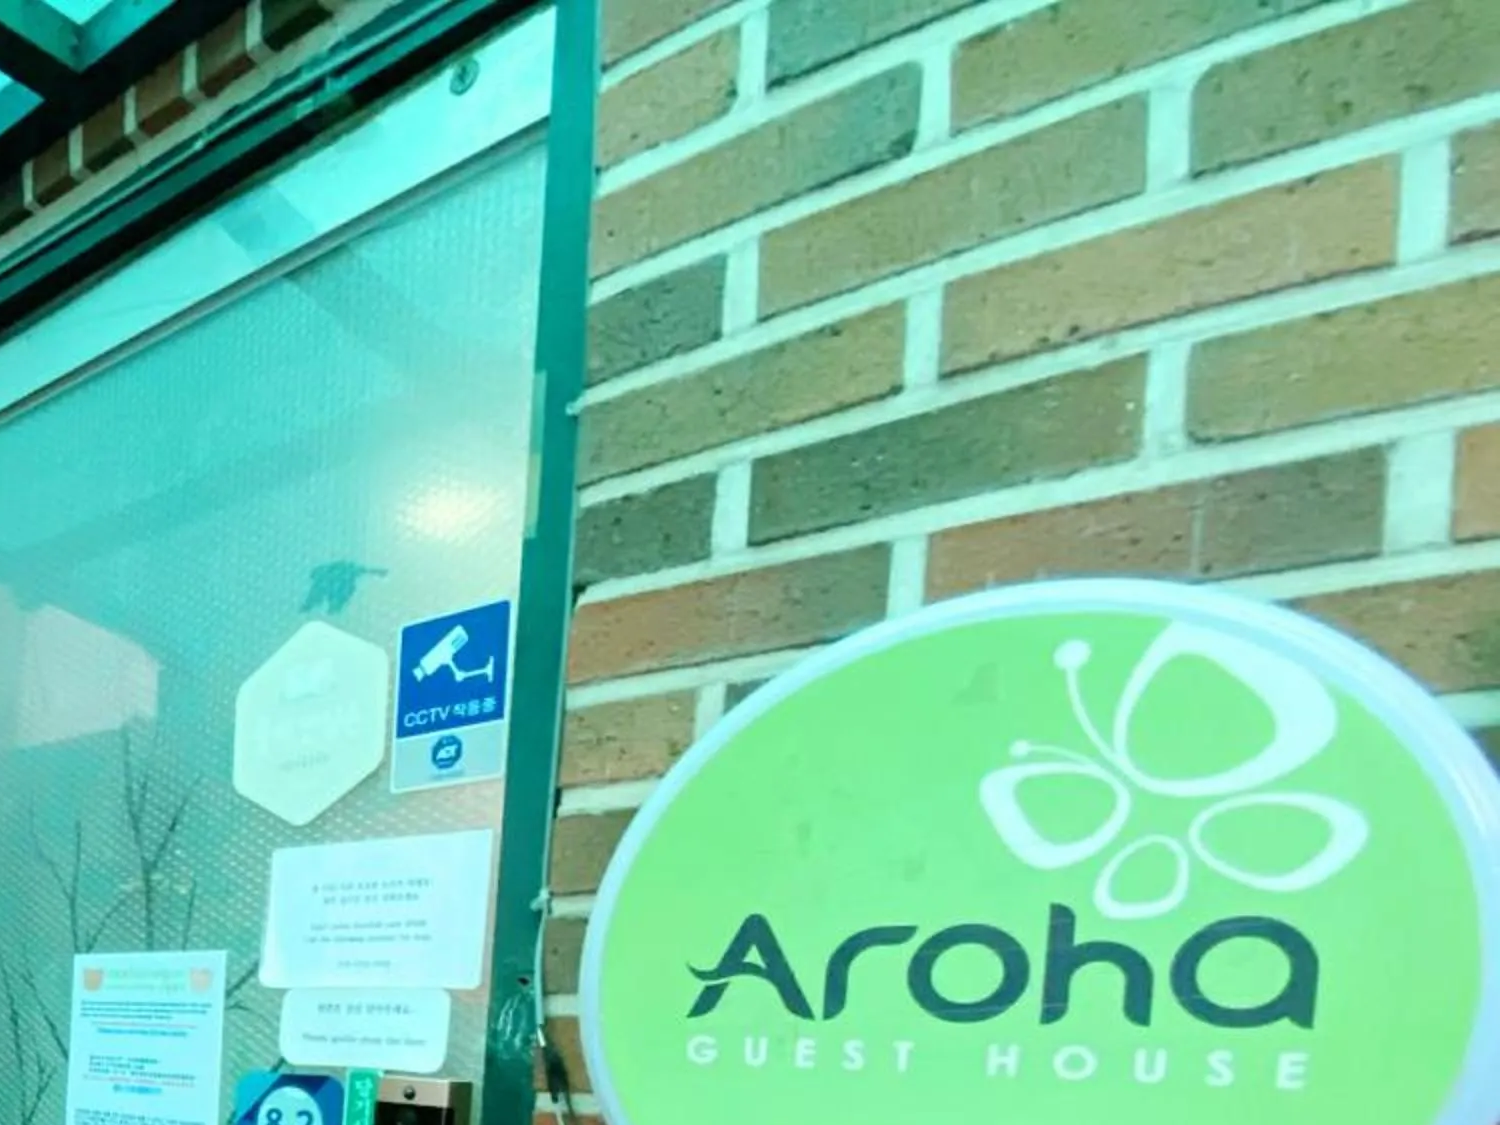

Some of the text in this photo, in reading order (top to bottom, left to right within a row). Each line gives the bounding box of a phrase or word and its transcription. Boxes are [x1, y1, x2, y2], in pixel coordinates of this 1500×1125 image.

[403, 705, 450, 728] CCTV
[686, 903, 1319, 1030] Aroha
[686, 1034, 1311, 1090] GUEST HOUSE
